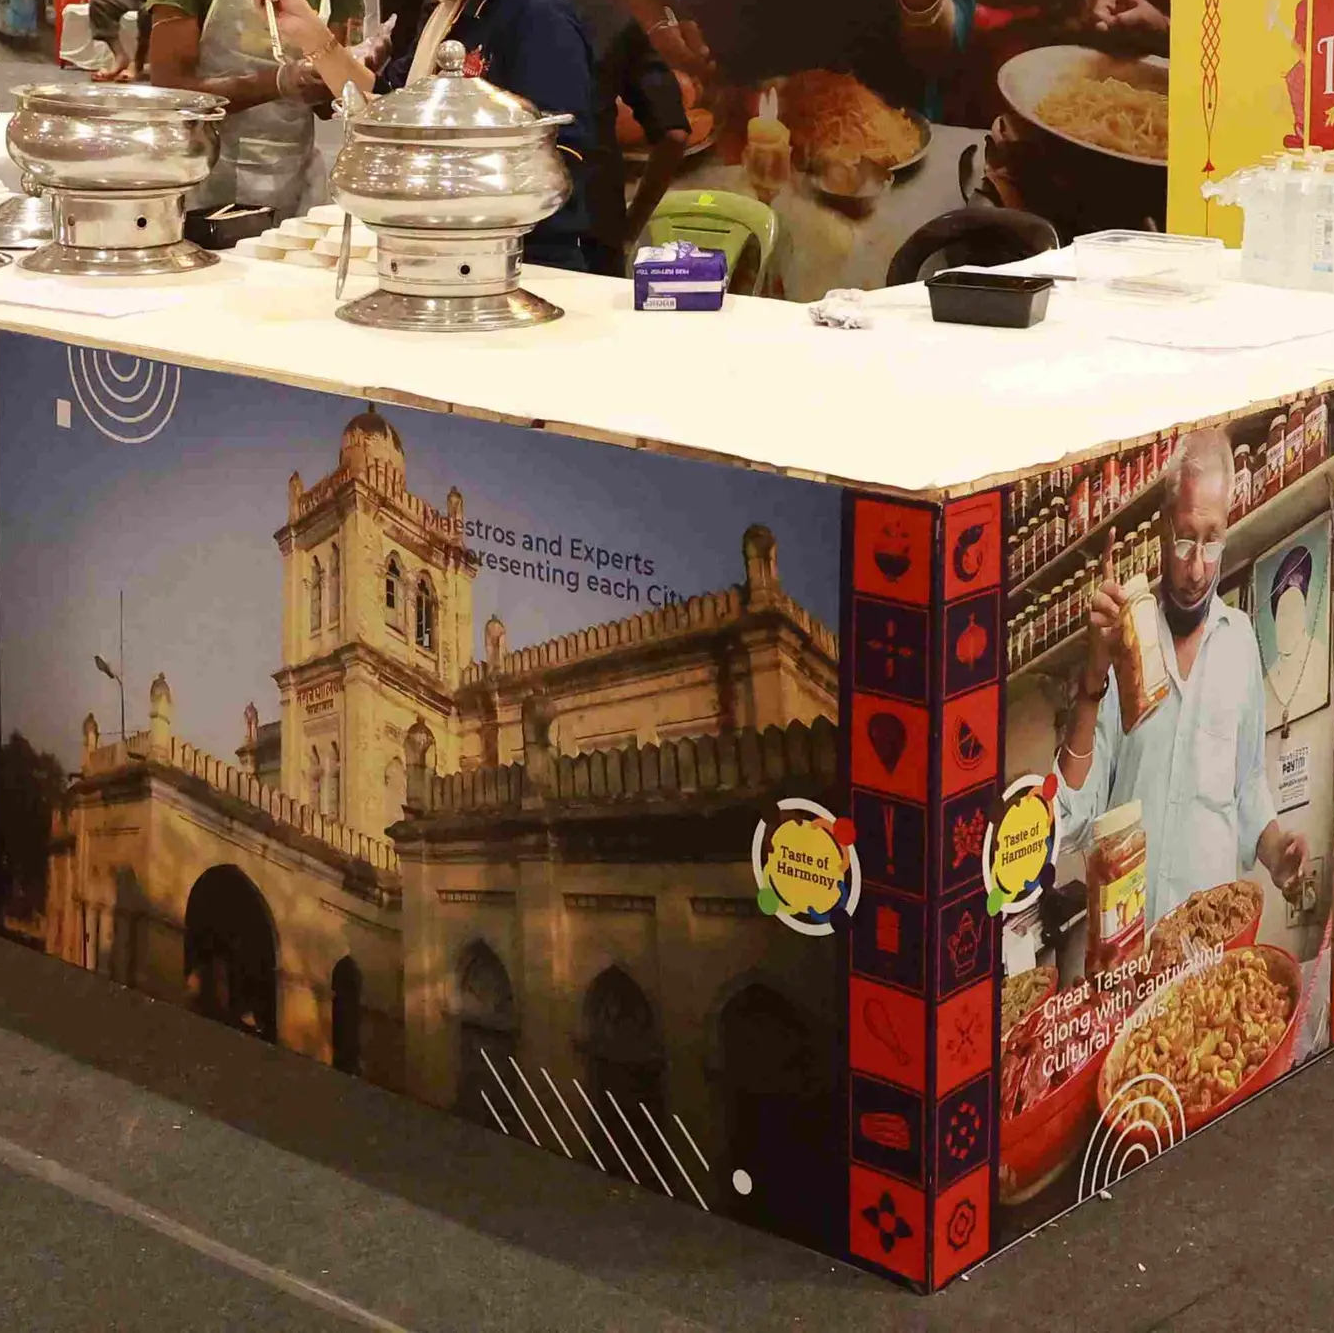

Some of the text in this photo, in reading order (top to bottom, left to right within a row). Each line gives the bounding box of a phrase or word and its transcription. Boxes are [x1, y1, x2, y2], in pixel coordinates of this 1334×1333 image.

[522, 535, 562, 556] and
[570, 538, 655, 576] Experts
[587, 574, 639, 603] each
[1004, 824, 1040, 850] Taste of
[780, 845, 829, 871] Taste of
[1001, 838, 1044, 867] Harmony
[776, 860, 836, 890] Harmony
[1043, 949, 1155, 1020] Great Tastery
[1043, 939, 1225, 1049] along with captivating
[1041, 1023, 1110, 1078] Cultural
